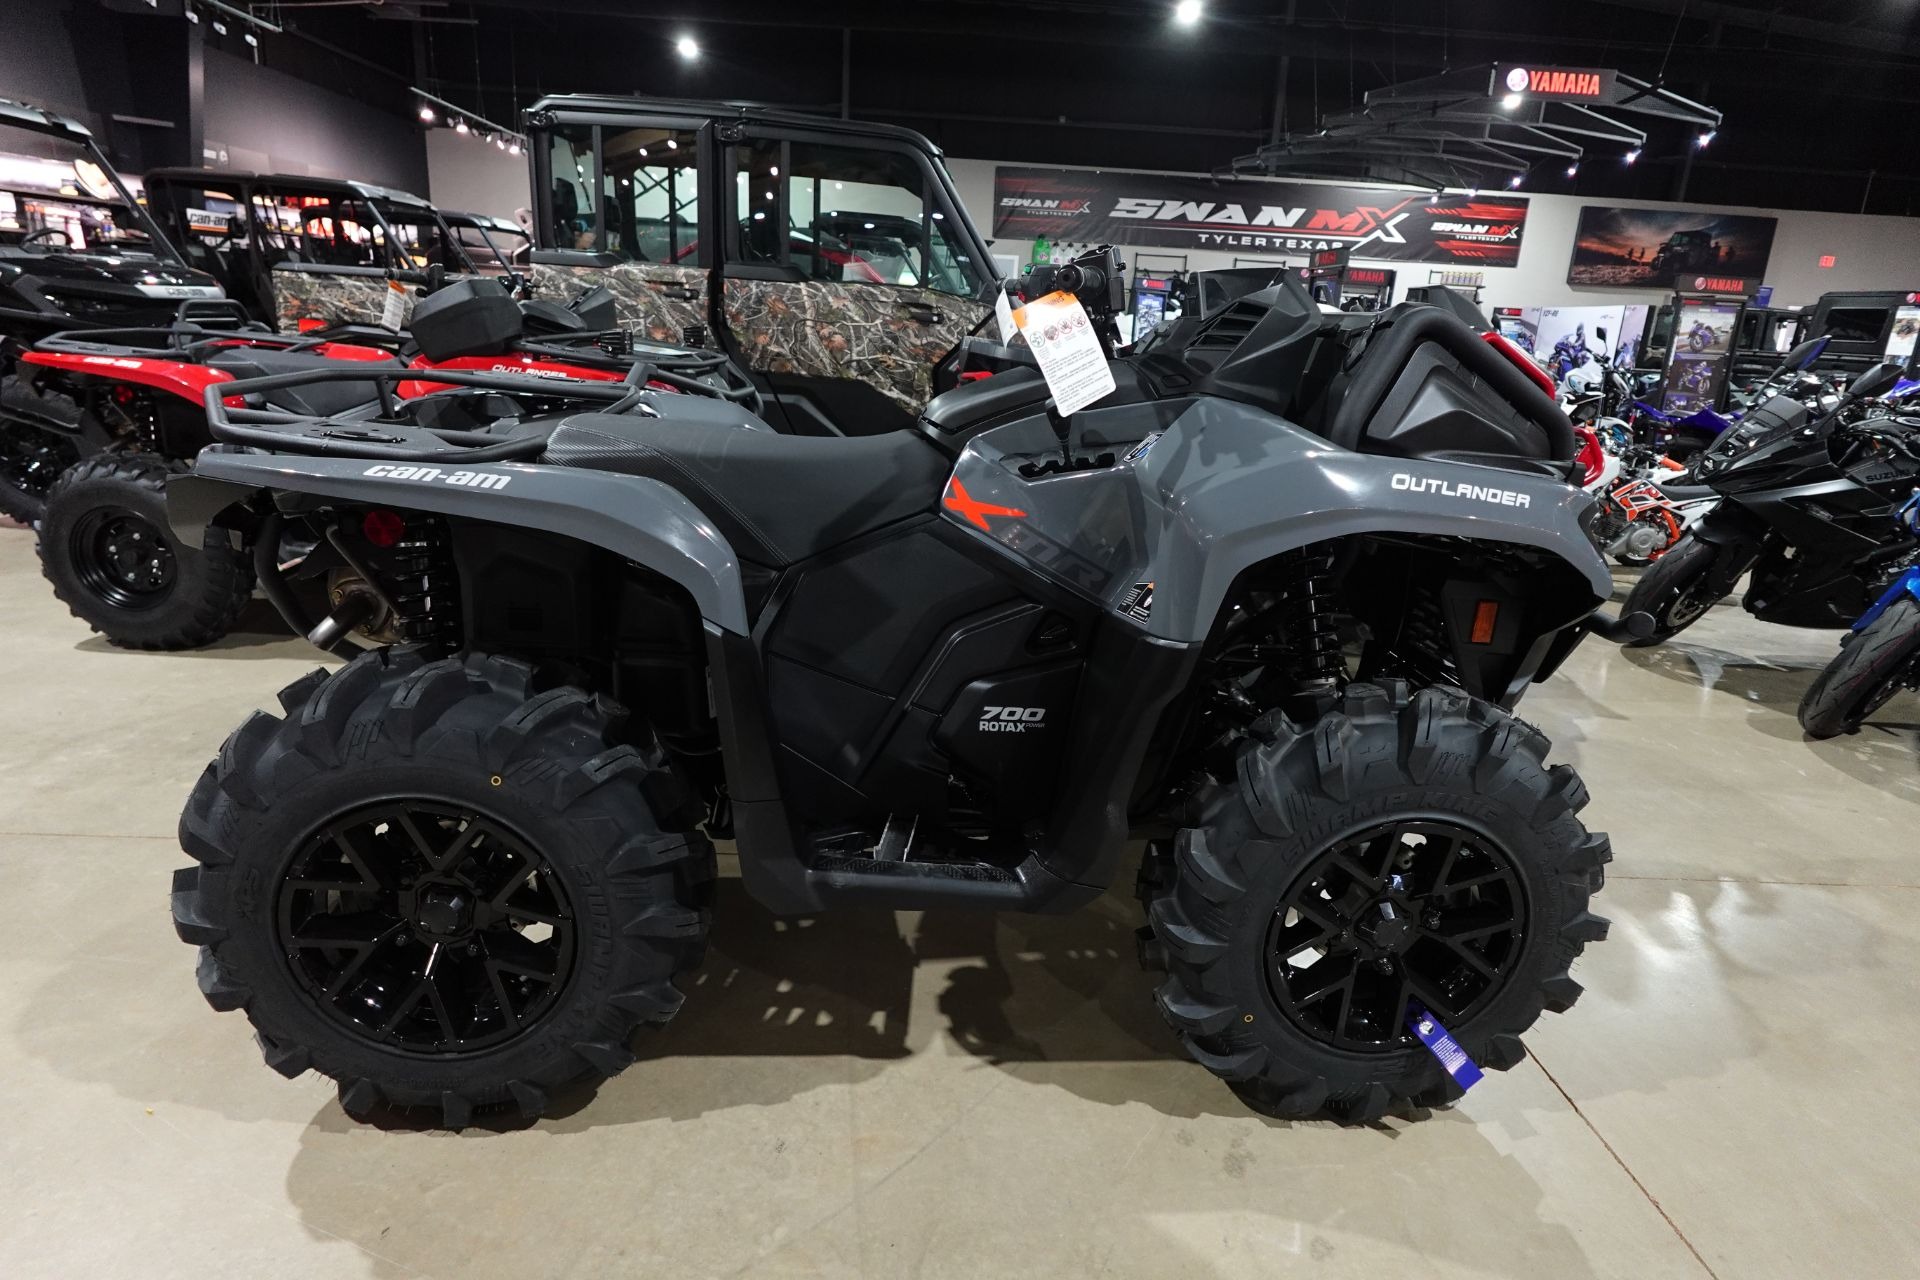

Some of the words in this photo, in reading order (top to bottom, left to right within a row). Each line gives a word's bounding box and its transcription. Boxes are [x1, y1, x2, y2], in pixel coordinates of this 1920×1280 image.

[1530, 70, 1600, 96] YAMAHA
[1000, 197, 1059, 208] SWAN
[1059, 198, 1091, 217] MX
[1108, 197, 1308, 228] SWAN
[1305, 195, 1417, 252] MX
[1430, 221, 1490, 235] SWAN
[1487, 222, 1520, 242] MX
[1198, 233, 1267, 247] TYLER
[1706, 278, 1744, 291] YAMAHA
[491, 364, 568, 378] OUTLANDER
[362, 465, 512, 490] can-am
[1391, 473, 1531, 509] OUTLANDER
[980, 706, 1046, 721] 700
[979, 721, 1026, 732] ROTAX
